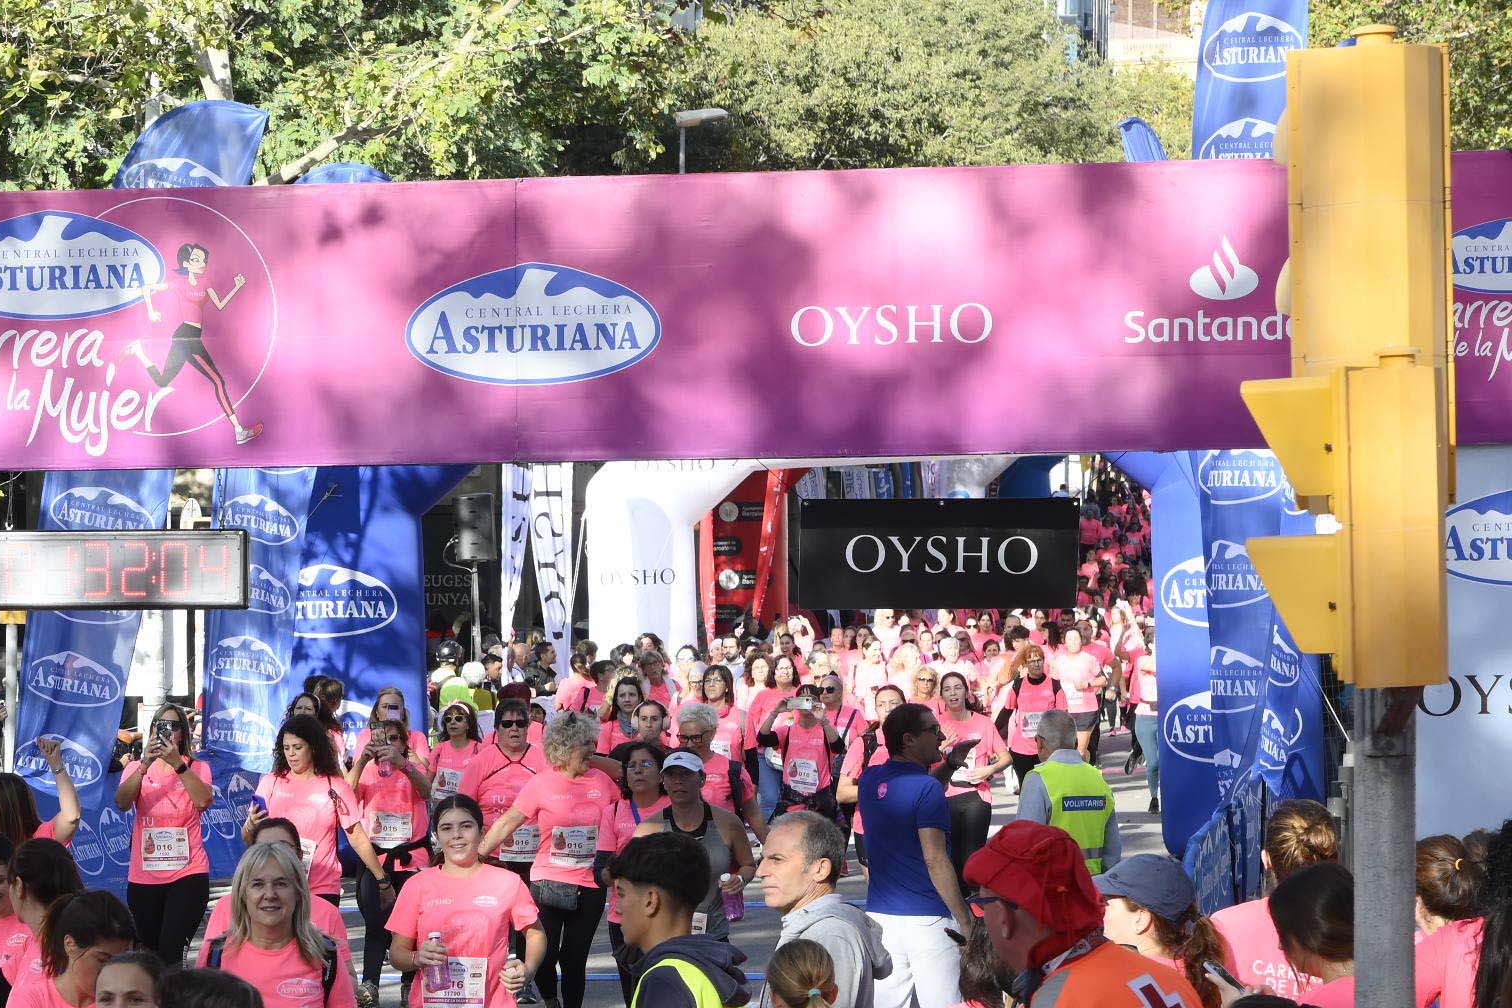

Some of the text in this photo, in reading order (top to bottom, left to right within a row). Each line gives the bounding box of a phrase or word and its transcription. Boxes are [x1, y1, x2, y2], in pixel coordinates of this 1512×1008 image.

[1212, 41, 1294, 66] ASTURIAN
[68, 246, 140, 258] LECHERA
[465, 302, 632, 319] CENTRAL LECHERA
[425, 311, 641, 355] ASTURIANA
[791, 301, 993, 347] OYSHO
[6, 373, 30, 412] la
[25, 360, 175, 456] Mujer
[845, 534, 1038, 575] OYSHO
[600, 567, 676, 585] OYSHO
[335, 590, 383, 598] LECHERA
[492, 795, 506, 804] TU
[1064, 799, 1105, 808] VOLUNTARIS
